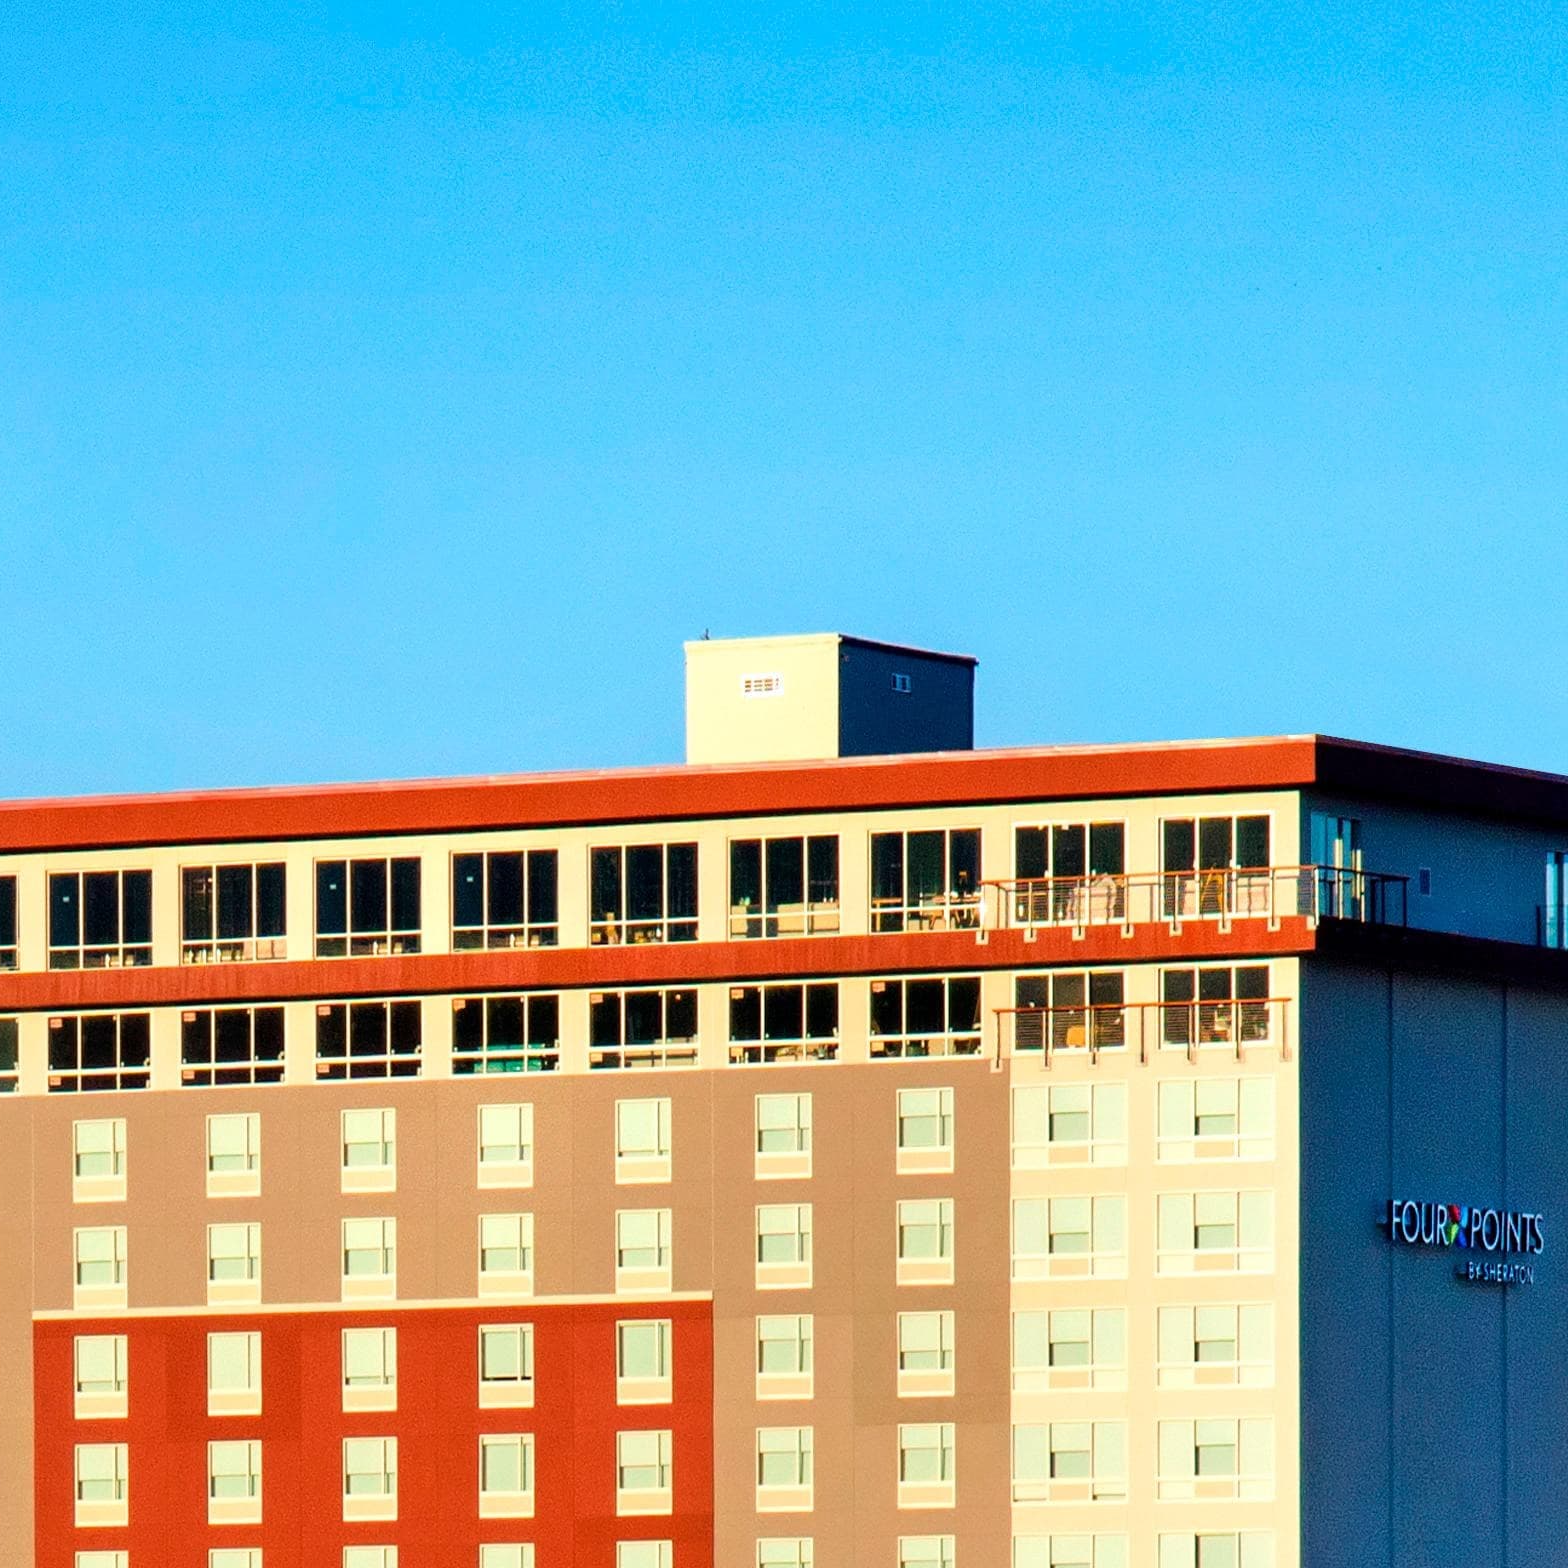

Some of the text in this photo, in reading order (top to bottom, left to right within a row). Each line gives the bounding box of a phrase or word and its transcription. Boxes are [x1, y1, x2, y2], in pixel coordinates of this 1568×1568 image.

[1392, 1200, 1545, 1255] FOUR POINTS
[1468, 1261, 1535, 1285] BY SHERATON
